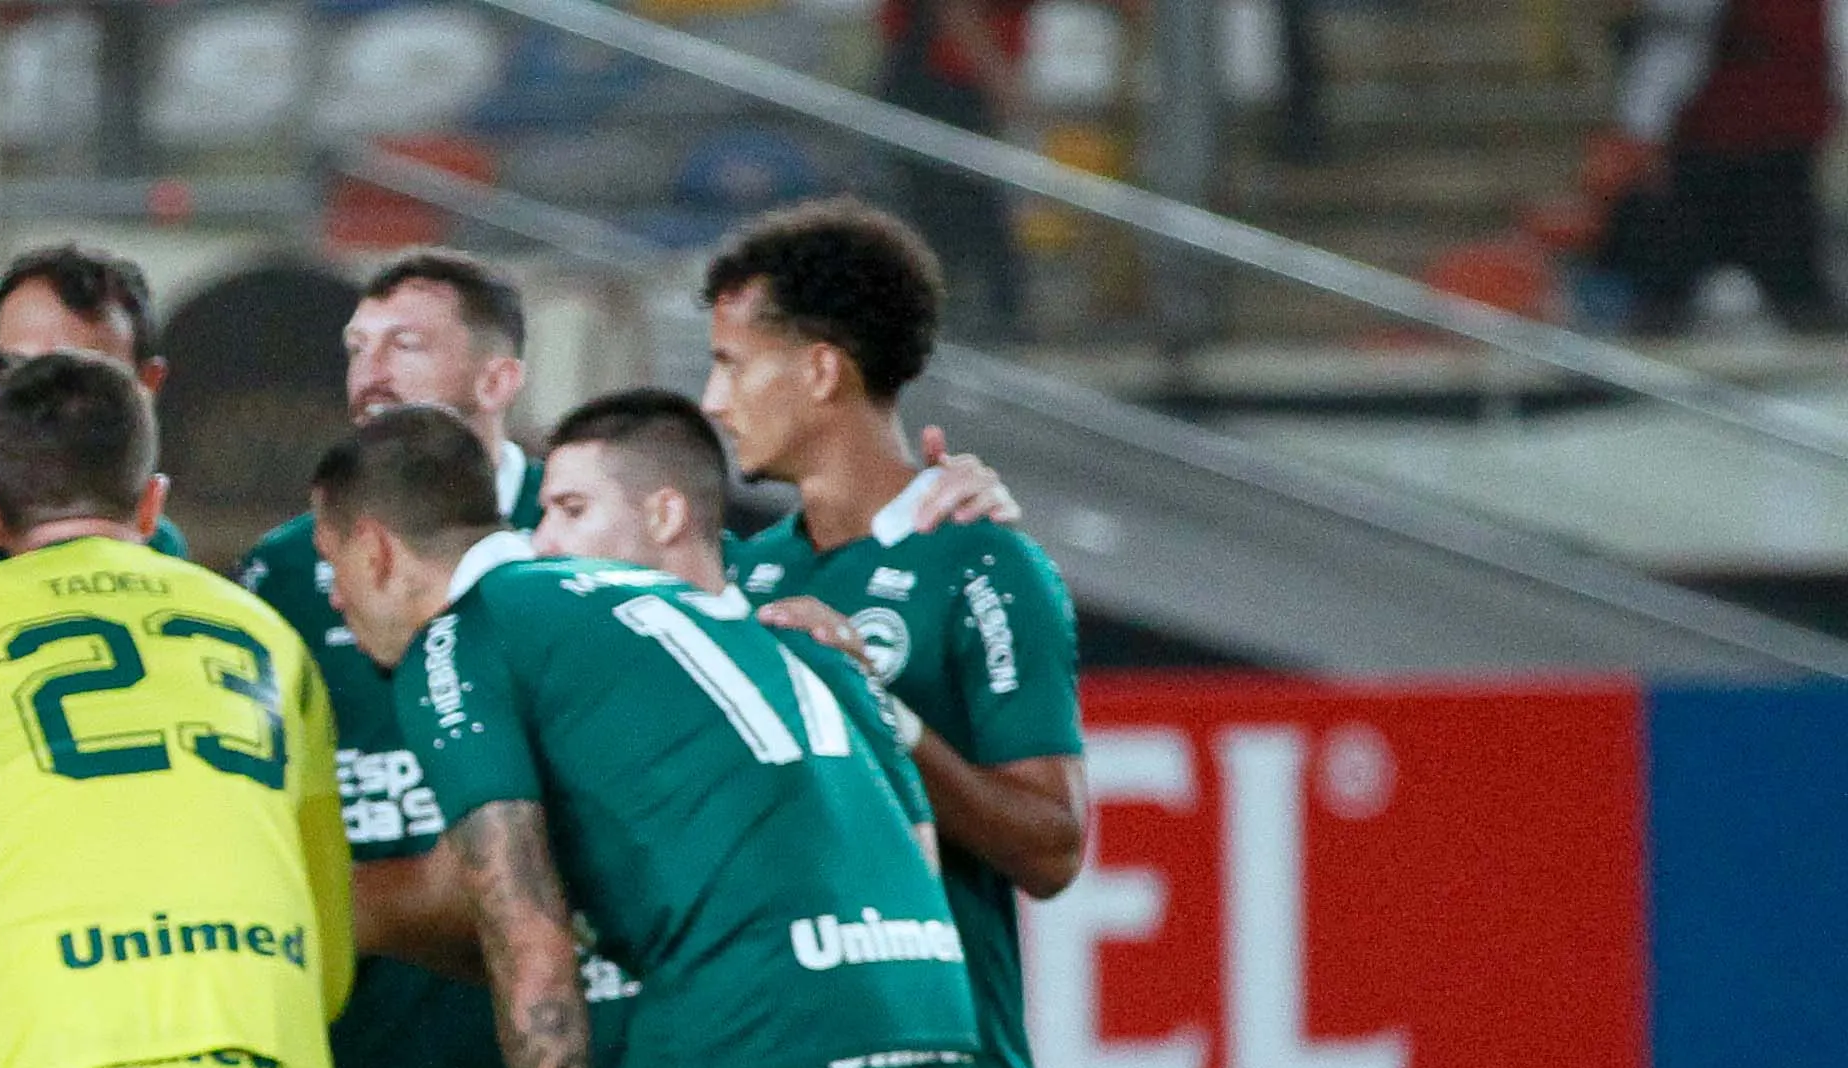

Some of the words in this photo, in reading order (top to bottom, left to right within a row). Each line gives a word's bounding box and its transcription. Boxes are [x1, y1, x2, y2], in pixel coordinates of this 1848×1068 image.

[43, 570, 171, 597] TADEU
[58, 913, 306, 969] Unimed
[790, 906, 965, 970] Unime
